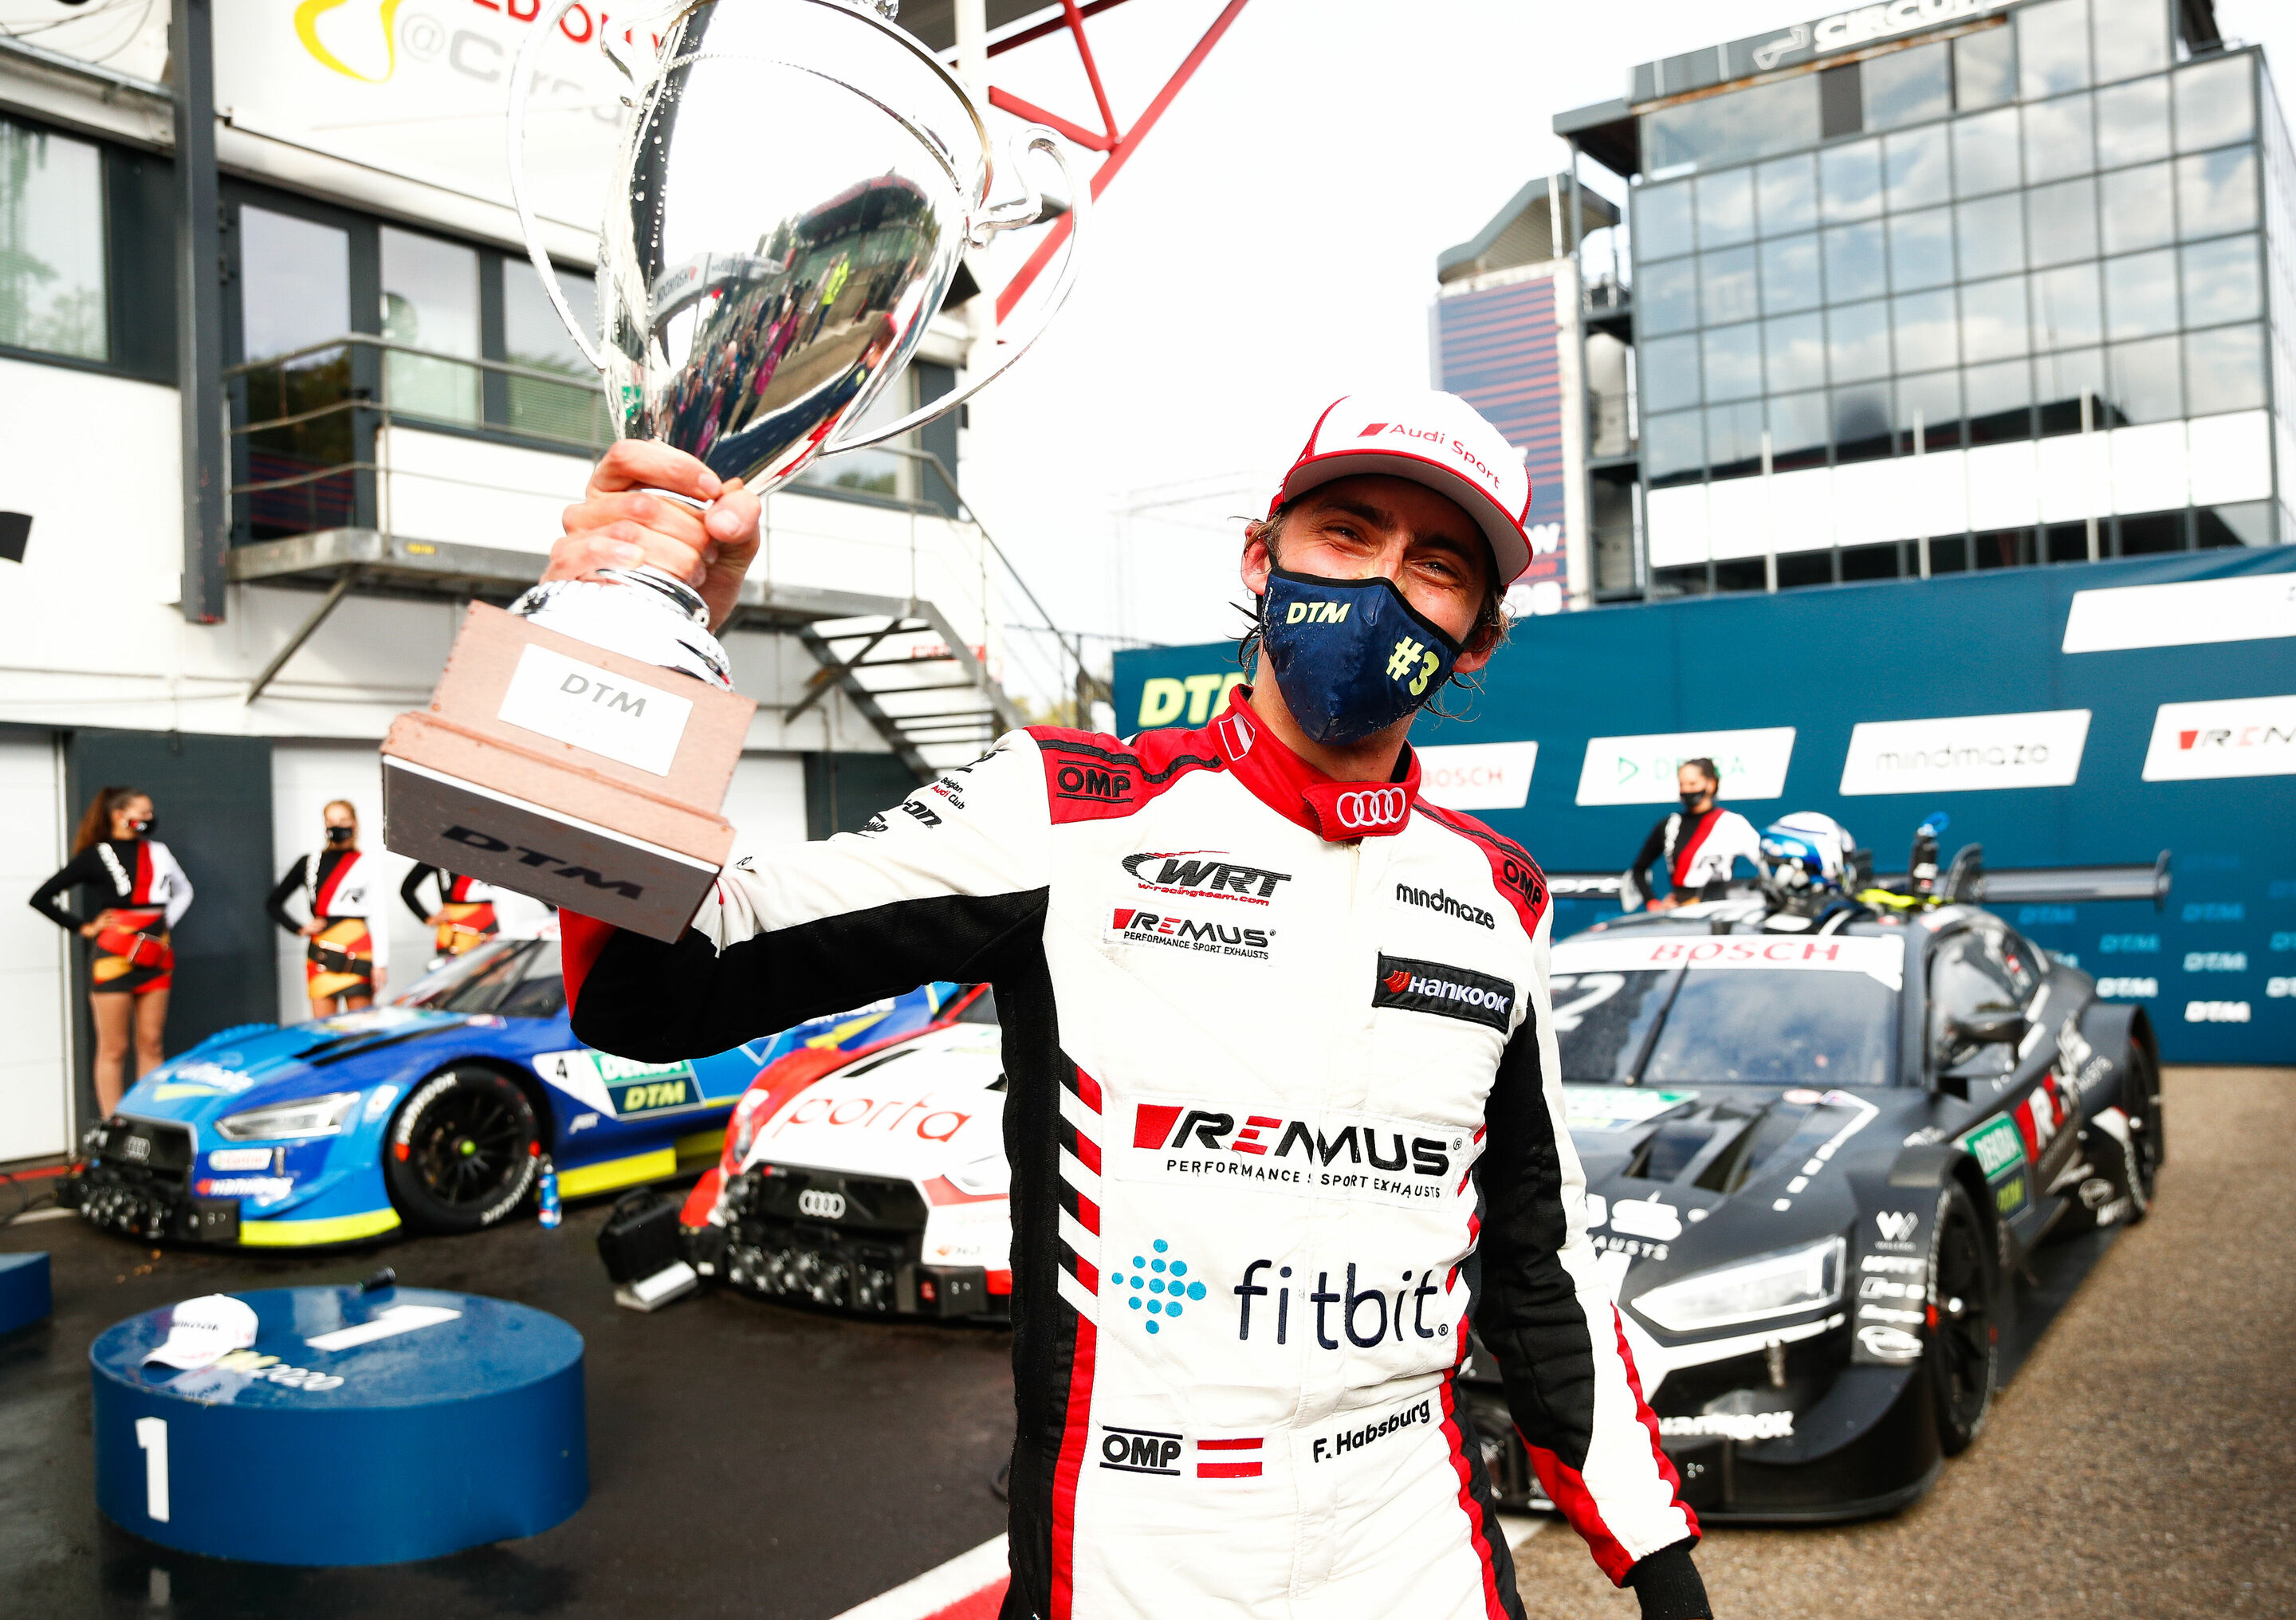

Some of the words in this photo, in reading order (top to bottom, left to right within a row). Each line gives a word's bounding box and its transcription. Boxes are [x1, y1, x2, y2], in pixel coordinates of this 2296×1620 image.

[1390, 423, 1446, 446] Audi
[1452, 438, 1502, 490] Sport
[1285, 601, 1352, 624] DTM
[1385, 635, 1440, 697] #3
[559, 673, 647, 718] DTM
[941, 777, 964, 794] Belgian
[1058, 766, 1132, 798] OMP
[1421, 766, 1504, 789] BOSCH
[931, 784, 951, 798] Audi
[948, 794, 965, 811] Club
[442, 825, 644, 901] DTM
[1155, 859, 1292, 898] WRT
[1504, 859, 1543, 906] OMP
[1138, 883, 1270, 906] w-racingteam.com
[1396, 883, 1496, 930] mindmaze
[1123, 930, 1189, 950] PERFORMANCE
[1193, 942, 1221, 955] SPORT
[1225, 946, 1269, 960] EXHAUSTS
[1130, 912, 1269, 949] REMUS
[1649, 942, 1841, 961] BOSCH
[556, 1059, 568, 1079] 4
[623, 1079, 687, 1112] DTM
[773, 1092, 973, 1143] porta
[1171, 1110, 1449, 1177] REMUS
[1166, 1159, 1300, 1184] PERFORMANCE
[1321, 1174, 1366, 1189] SPORT
[1374, 1178, 1440, 1198] EXHAUSTS
[1233, 1260, 1438, 1350] fitbit
[1313, 1439, 1332, 1463] F.
[1335, 1399, 1431, 1456] Habsburg
[135, 1417, 170, 1524] 1
[1102, 1434, 1181, 1468] OMP
